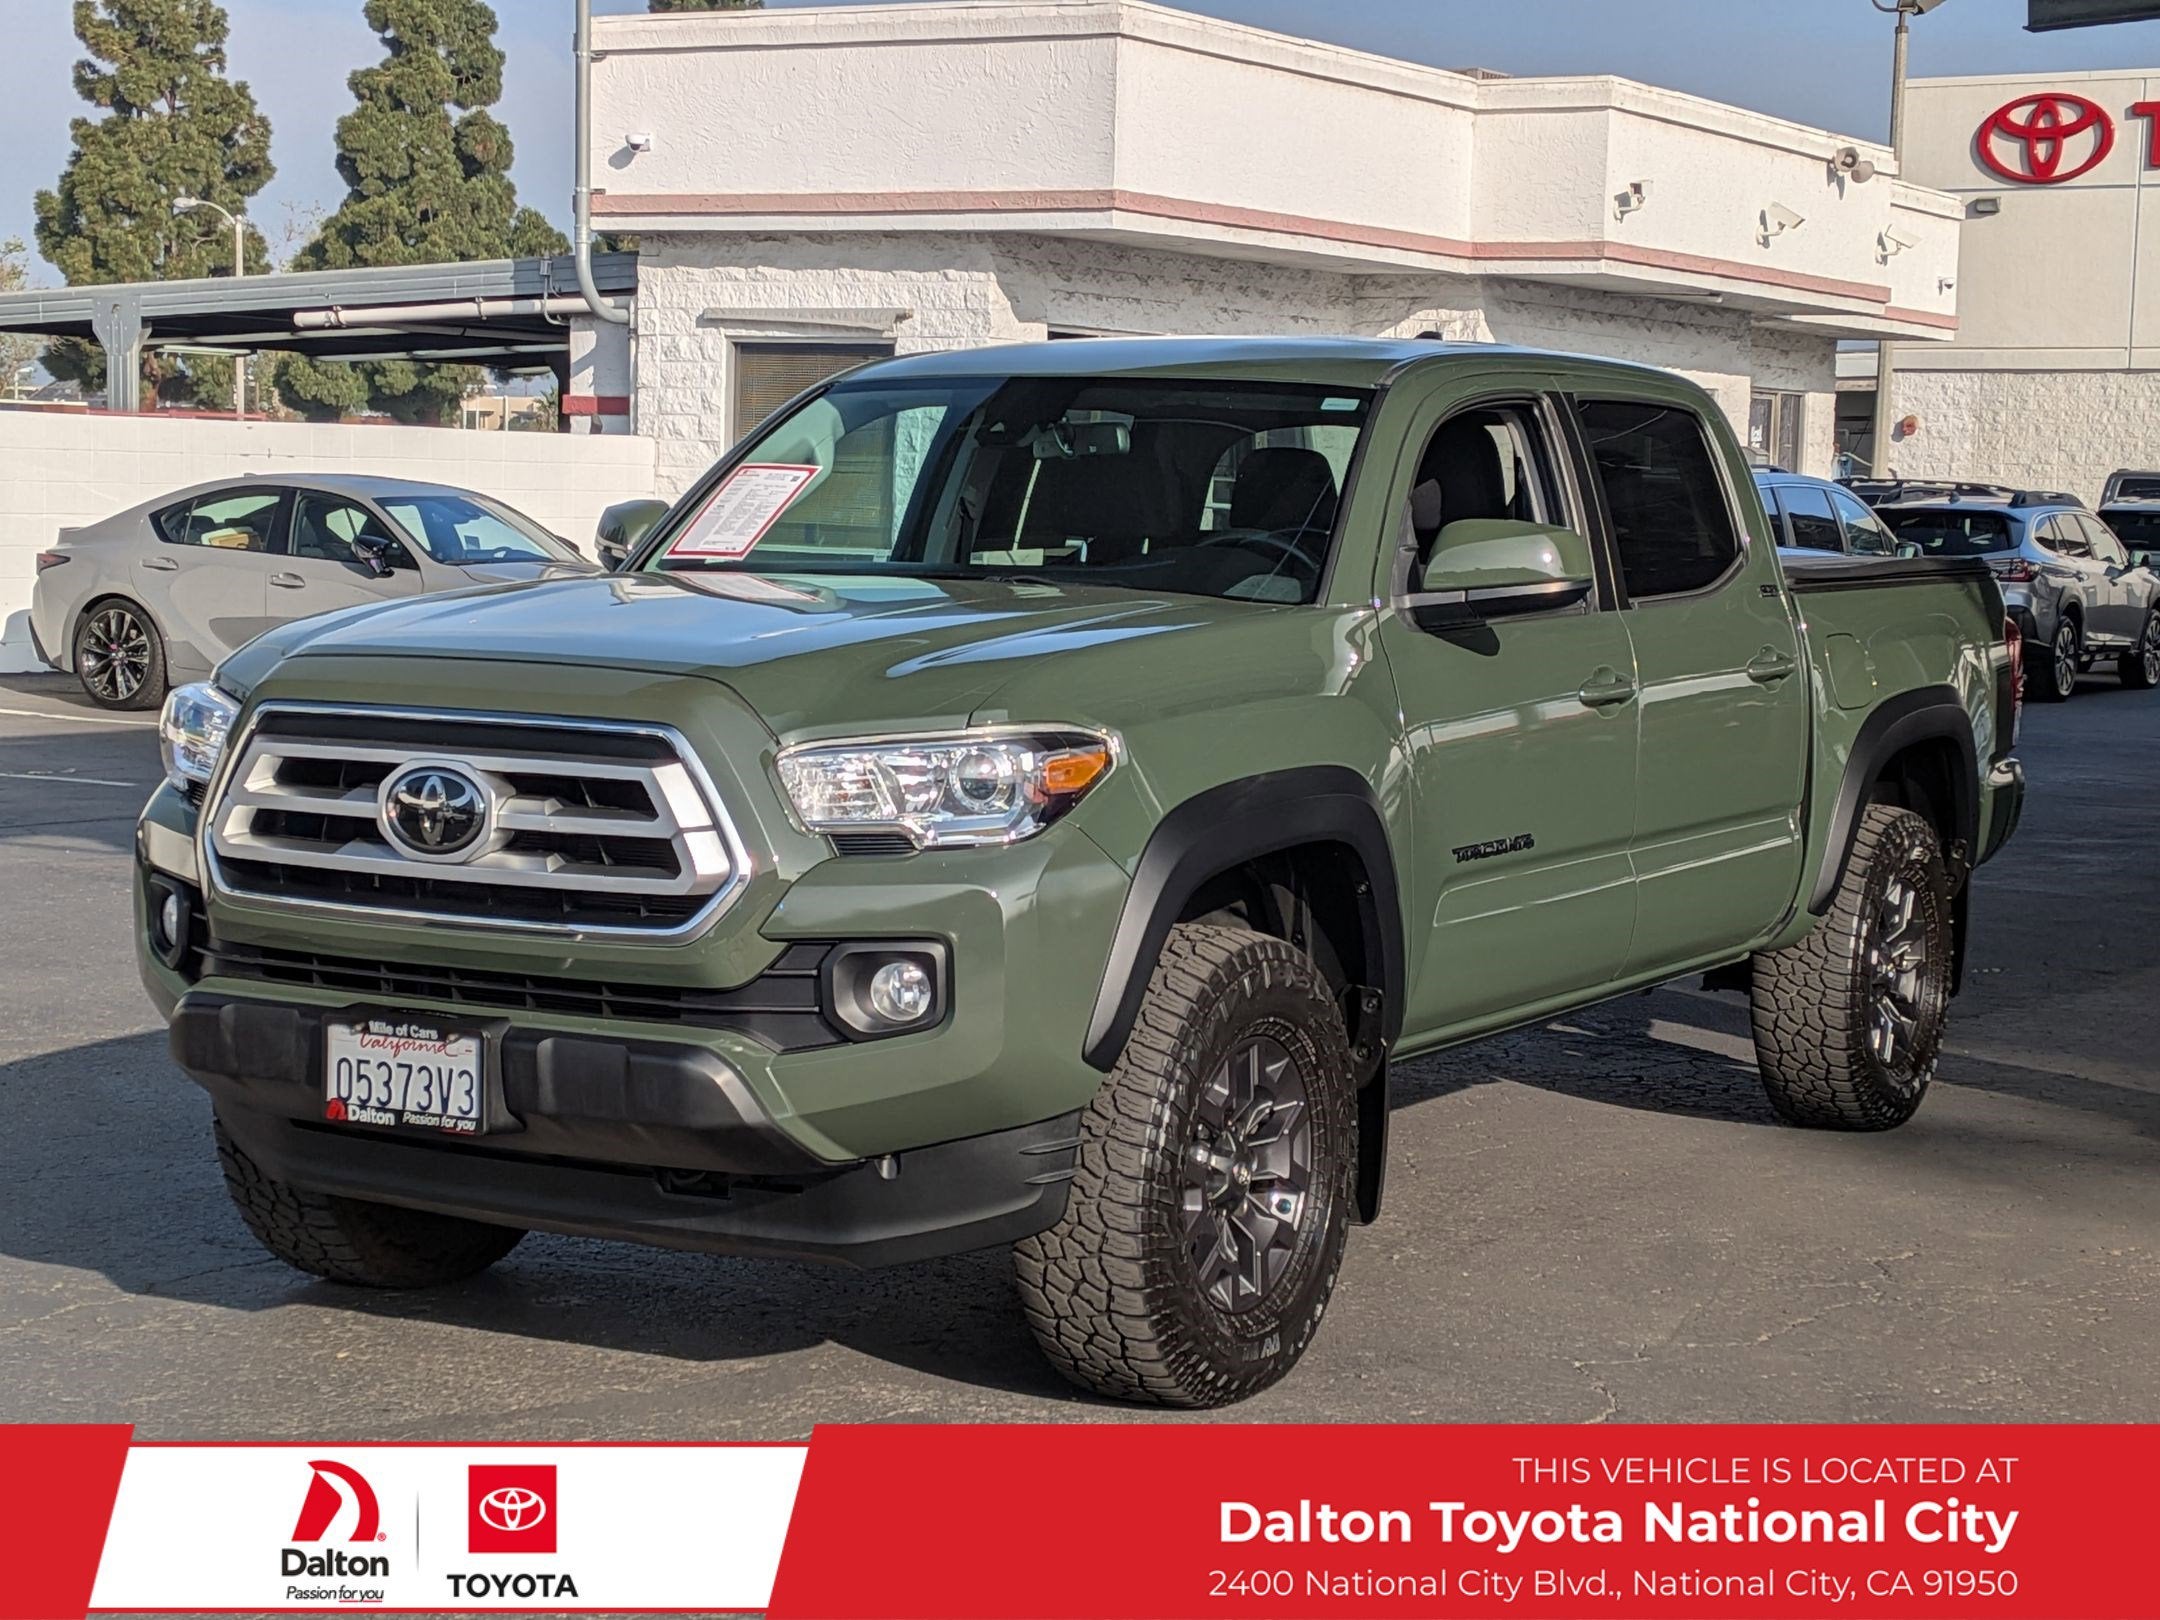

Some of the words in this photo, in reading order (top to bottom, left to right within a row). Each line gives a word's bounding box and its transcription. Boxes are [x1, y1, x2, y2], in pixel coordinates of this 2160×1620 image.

[368, 1020, 393, 1035] Mile
[395, 1023, 409, 1036] of
[409, 1025, 439, 1040] Cars
[335, 1057, 475, 1117] 05373V3
[347, 1104, 396, 1126] Dalton
[402, 1111, 440, 1127] Passion
[441, 1114, 456, 1129] for
[456, 1118, 477, 1132] you
